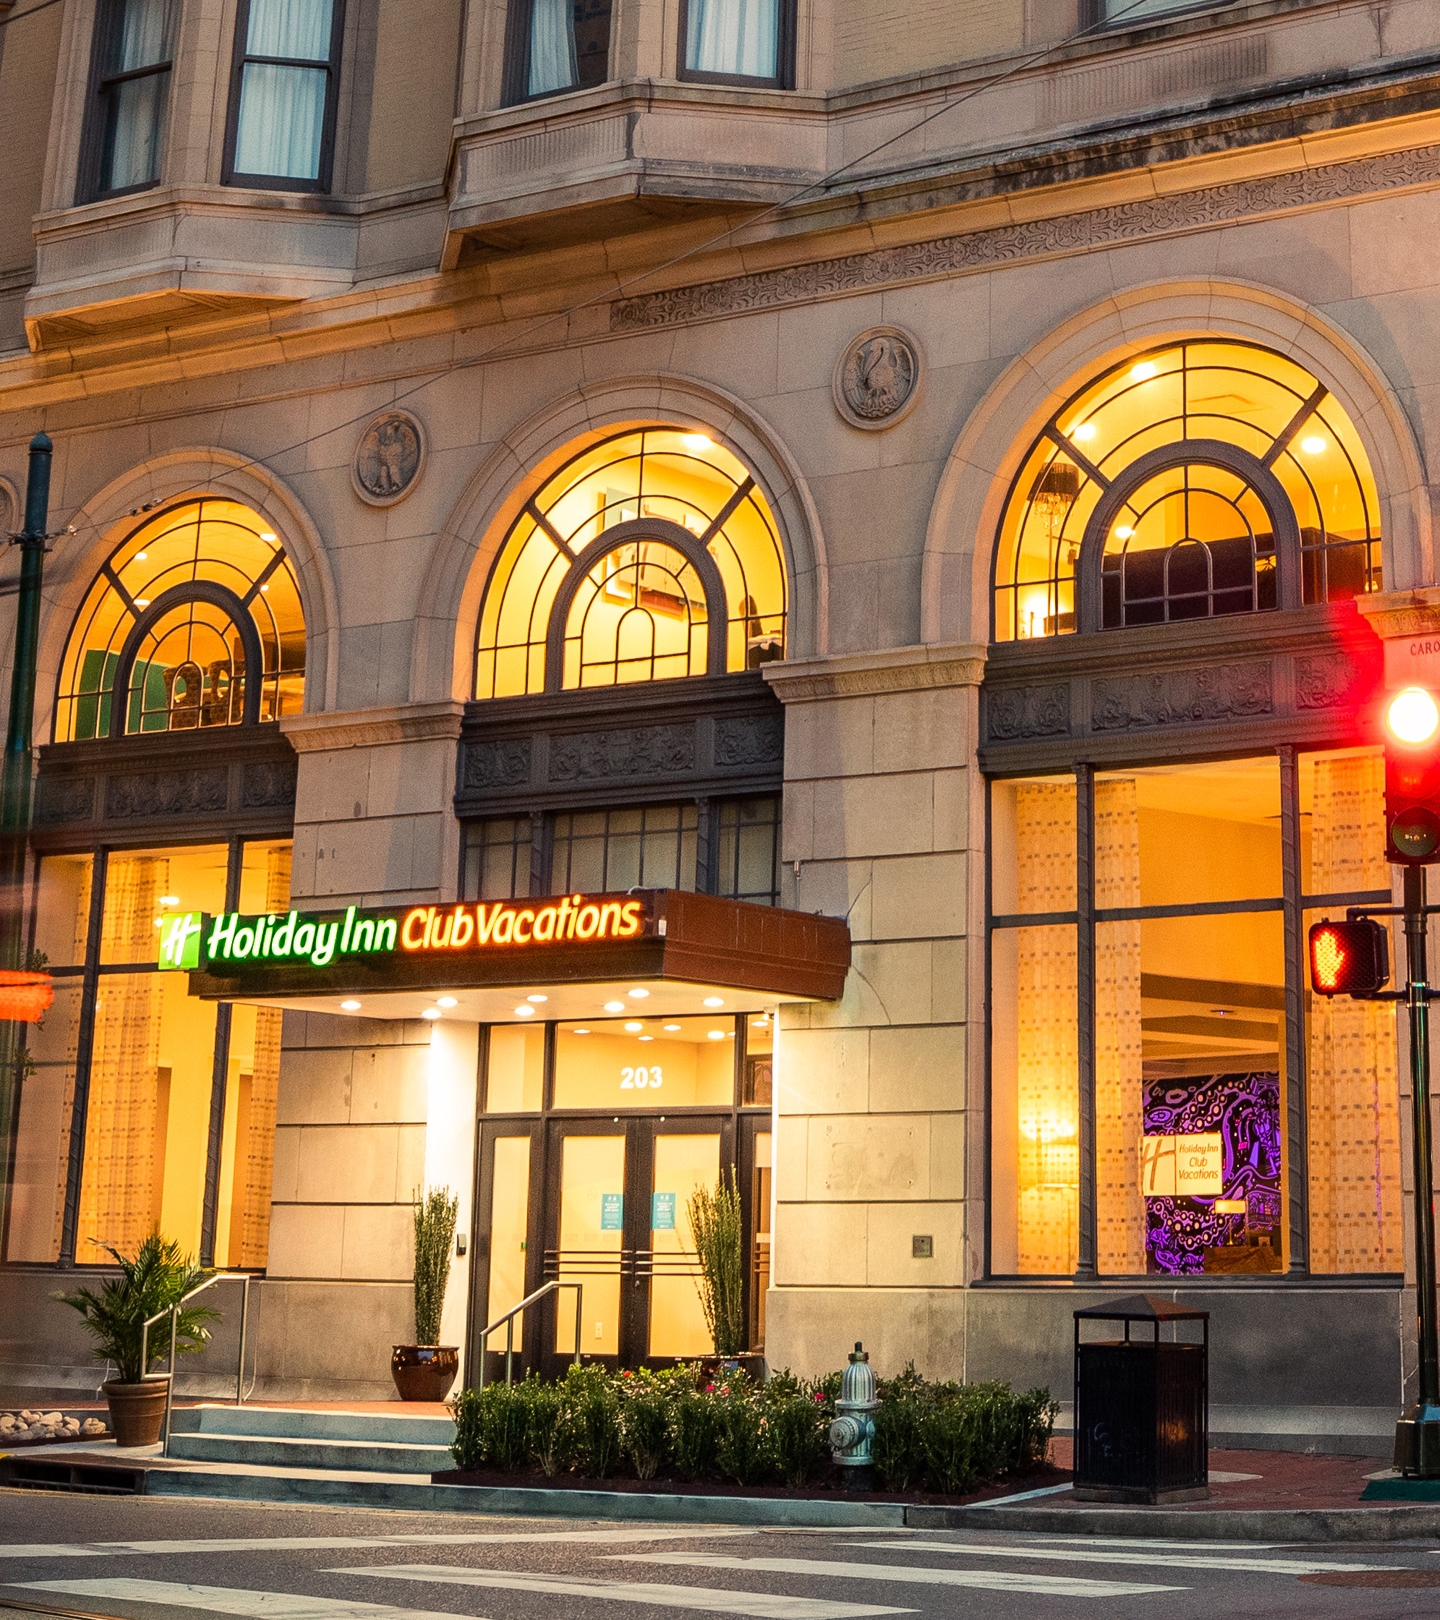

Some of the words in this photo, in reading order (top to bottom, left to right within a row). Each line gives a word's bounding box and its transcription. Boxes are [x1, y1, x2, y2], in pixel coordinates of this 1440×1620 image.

[208, 910, 338, 967] Holiday
[340, 905, 398, 954] Inn
[401, 905, 474, 949] Club
[477, 894, 641, 945] Vacations
[620, 1066, 662, 1089] 203
[1179, 1144, 1206, 1155] Holiday
[1207, 1143, 1219, 1153] Inn
[1189, 1156, 1208, 1167] Club
[1179, 1168, 1219, 1180] Vacations
